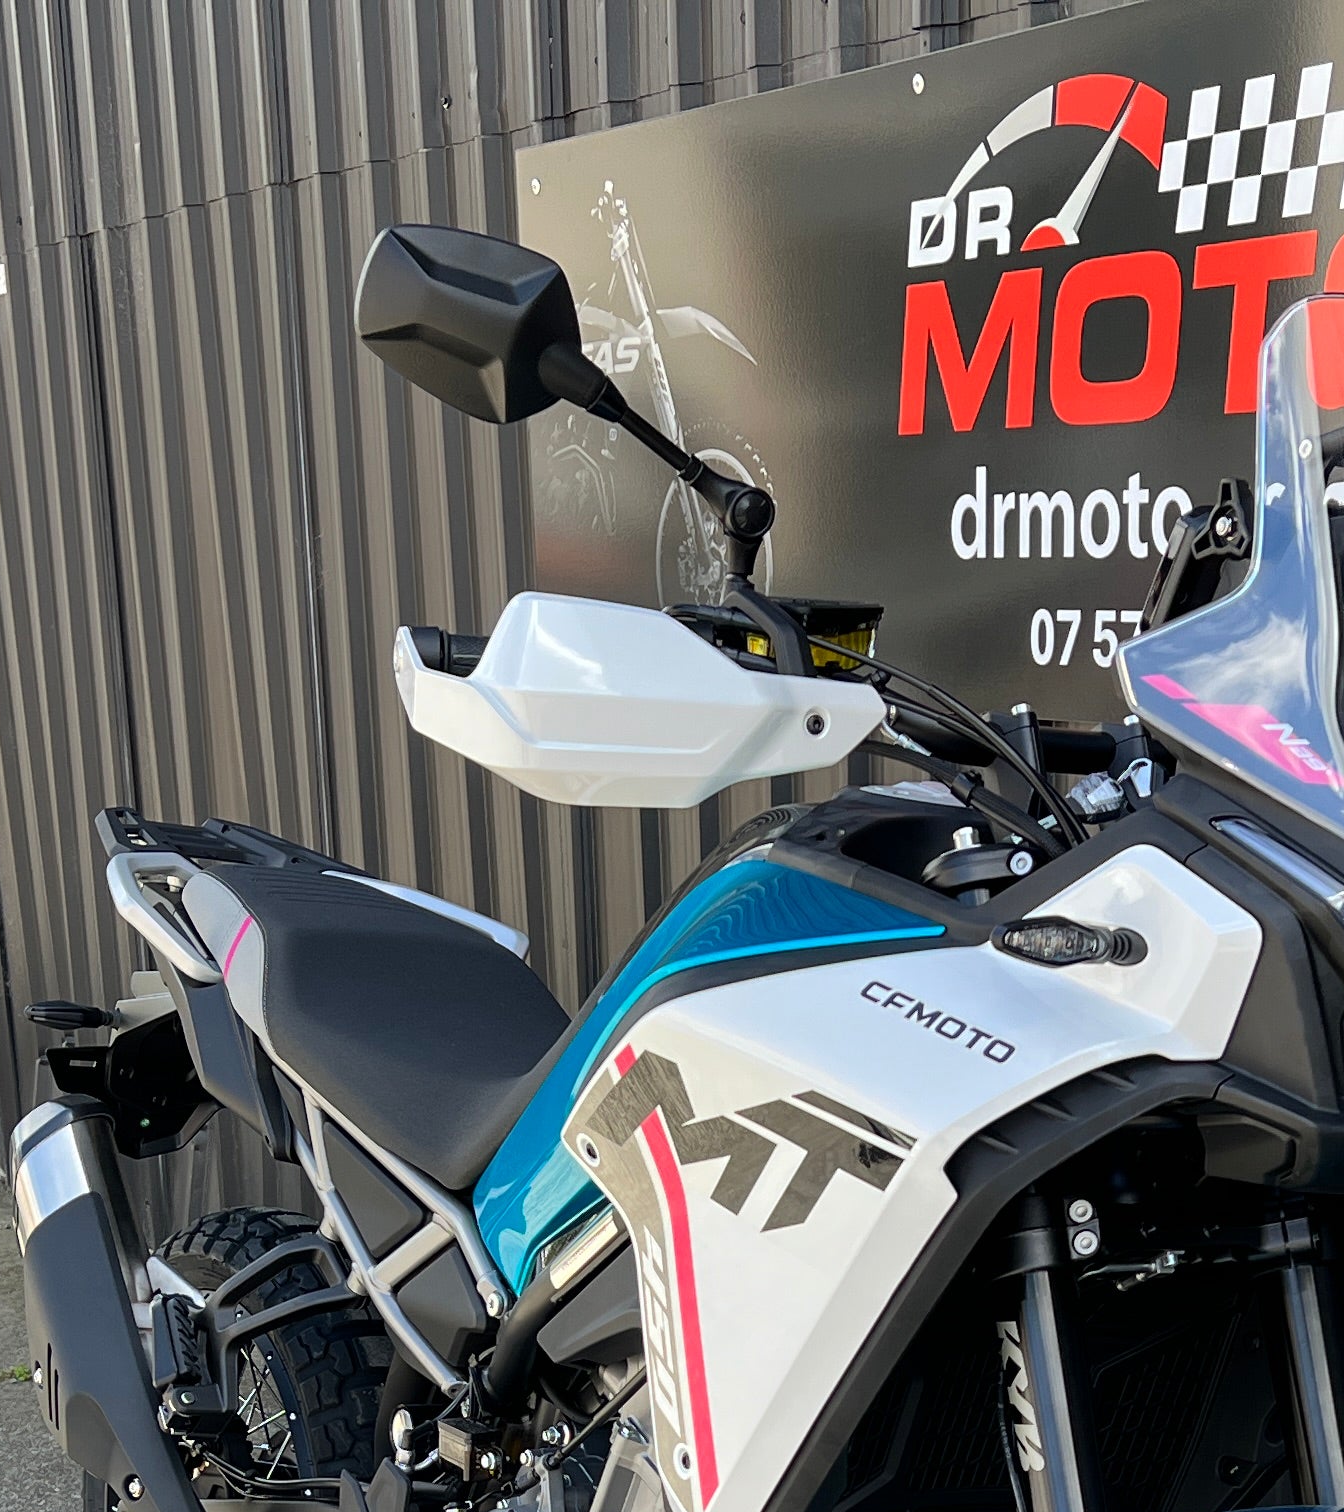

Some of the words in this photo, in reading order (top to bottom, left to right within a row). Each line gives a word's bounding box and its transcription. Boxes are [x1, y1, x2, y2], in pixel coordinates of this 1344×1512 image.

[908, 186, 1013, 268] DR
[1030, 608, 1081, 666] 07
[860, 981, 1016, 1063] CFMOTO
[585, 1049, 919, 1233] MT
[641, 1224, 683, 1438] 450
[996, 1321, 1046, 1472] KYB
